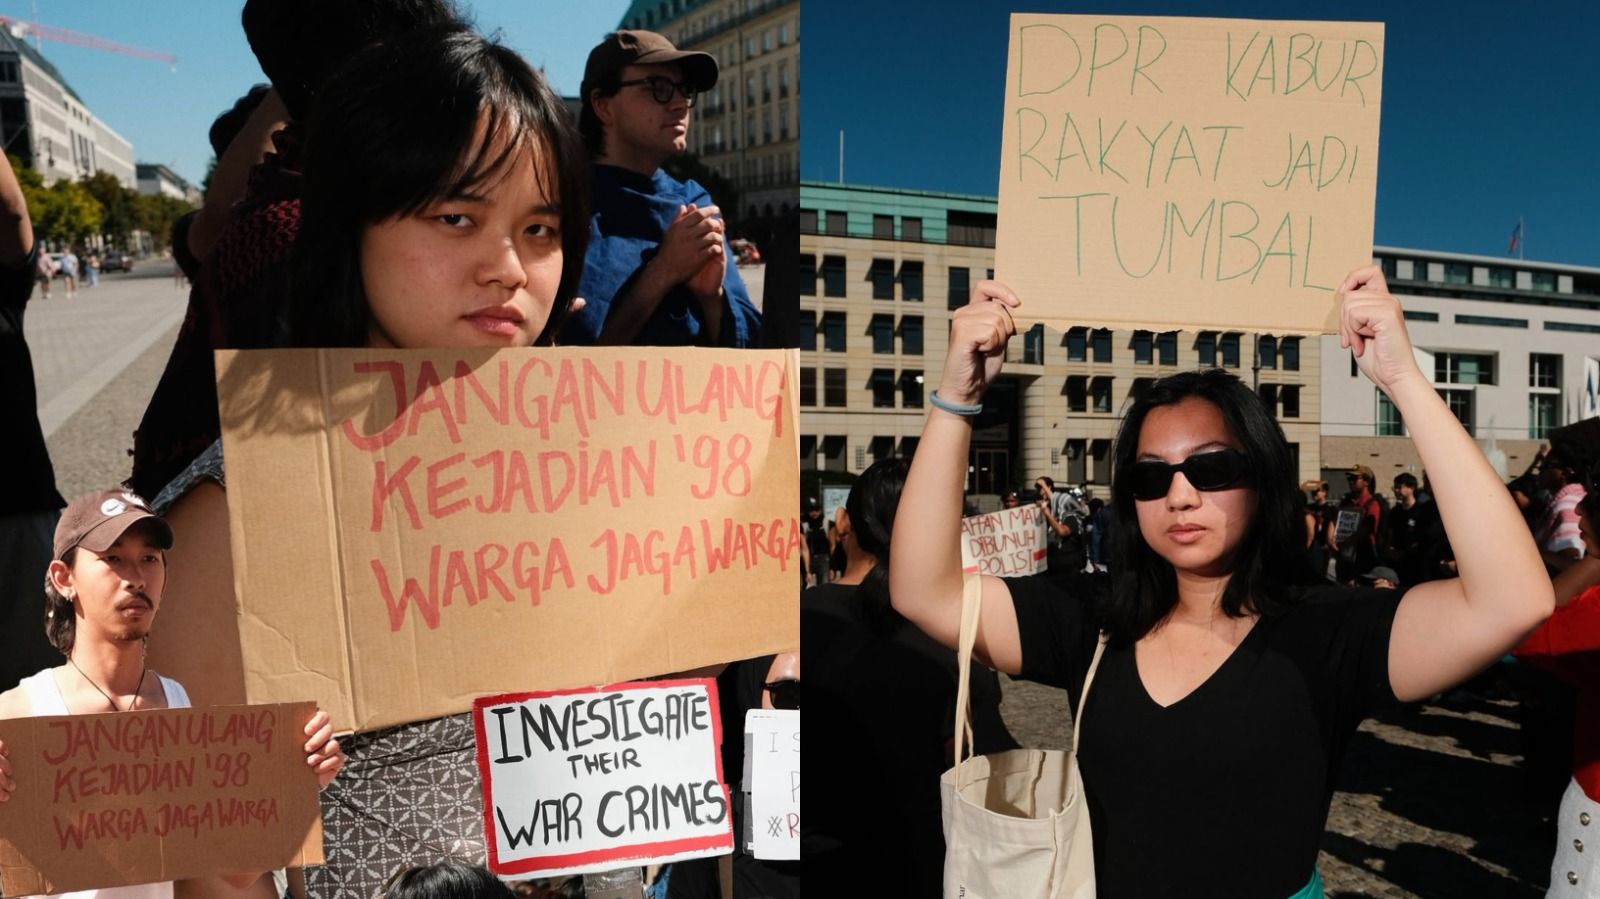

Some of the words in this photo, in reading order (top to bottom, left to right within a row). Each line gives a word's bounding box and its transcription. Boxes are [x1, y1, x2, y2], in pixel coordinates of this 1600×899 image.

[1018, 23, 1168, 98] DPR
[1225, 32, 1379, 108] KABUR
[1015, 106, 1245, 190] RAKYAT
[1261, 130, 1359, 192] JADI
[1037, 192, 1336, 292] TUMBAL
[342, 356, 626, 453] JANGAN
[635, 356, 787, 438] ULANG
[370, 438, 658, 533] KEJADIAN
[675, 433, 754, 500] '98
[961, 513, 1005, 536] AFFAN
[969, 529, 1035, 558] DIBUNUH
[370, 535, 576, 632] WARGA
[586, 527, 698, 596] JAGA
[700, 515, 800, 574] WARGA
[978, 549, 1033, 575] POLISI
[43, 713, 180, 766] JANGAN
[187, 709, 277, 753] ULANG
[490, 692, 708, 764] INVESTIGATE
[566, 747, 643, 779] THEIR
[52, 757, 196, 805] KEJADIAN
[205, 752, 251, 789] '98
[52, 808, 149, 851] WARGA
[152, 803, 215, 839] JAGA
[216, 798, 280, 829] WARGA
[496, 792, 583, 850] WAR
[597, 780, 727, 838] CRIMES
